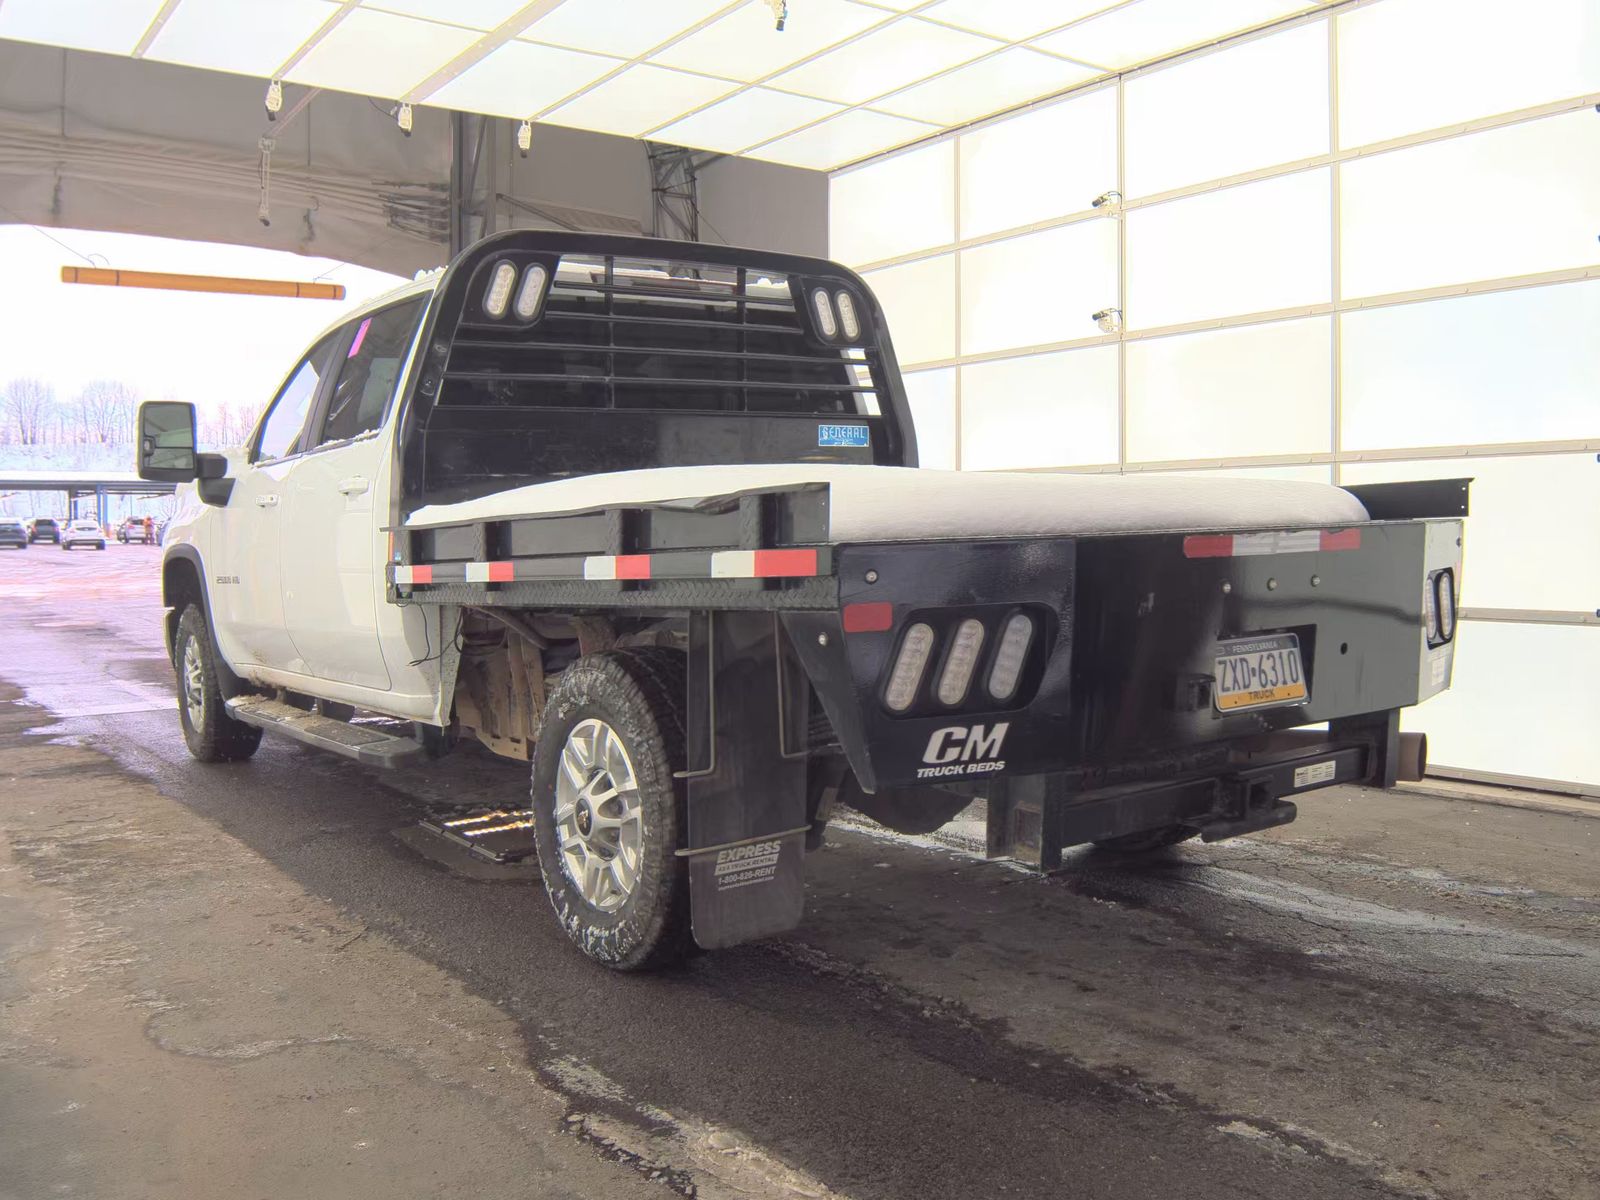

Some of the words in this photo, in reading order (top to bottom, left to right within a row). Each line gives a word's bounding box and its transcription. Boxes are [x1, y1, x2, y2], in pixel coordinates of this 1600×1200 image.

[821, 426, 865, 440] GENERAL
[1231, 640, 1278, 653] PENNSYLVANIA
[1248, 689, 1275, 700] TRUCK
[922, 722, 1010, 764] CM
[917, 765, 965, 778] TRUCK
[966, 761, 1006, 773] BEDS
[716, 840, 782, 864] EXPRESS
[752, 857, 776, 866] RENTAL
